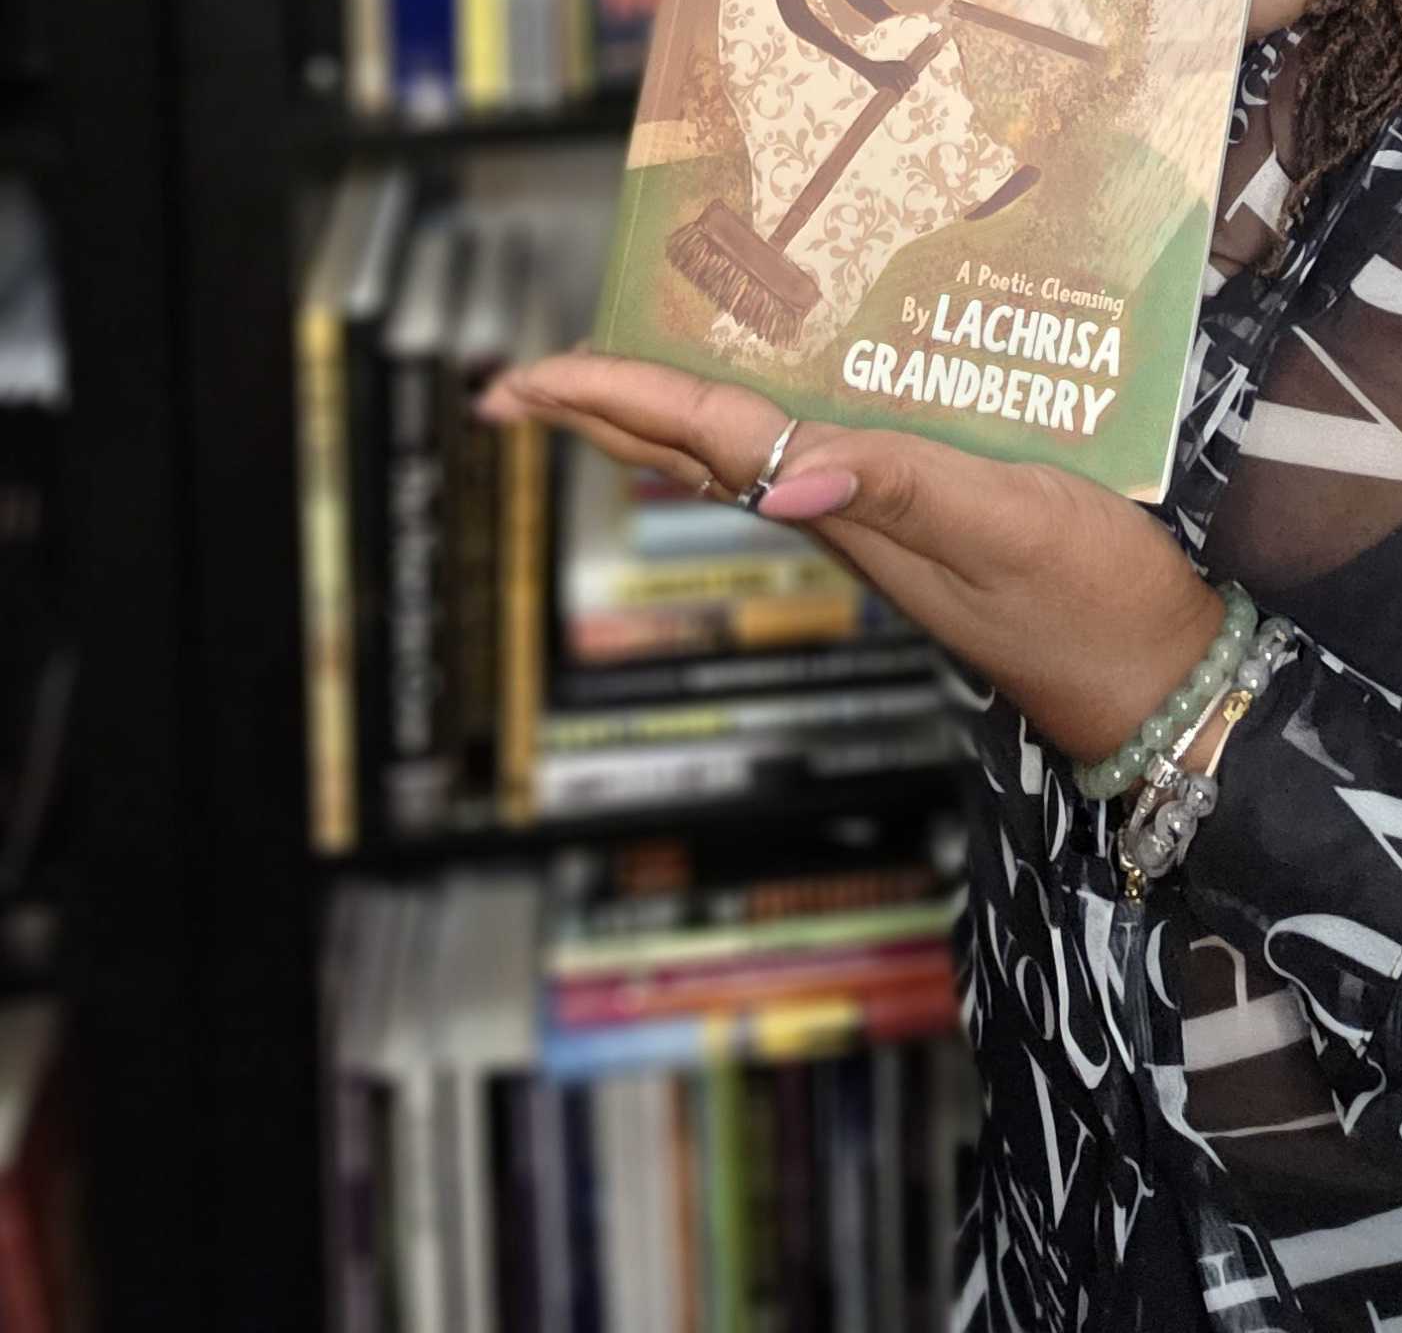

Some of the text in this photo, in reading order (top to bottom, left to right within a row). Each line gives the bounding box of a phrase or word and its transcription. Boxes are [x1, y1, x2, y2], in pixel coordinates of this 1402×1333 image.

[956, 260, 1125, 321] A Poetic Cleansing
[901, 293, 1122, 377] By LACHRISA
[842, 339, 1117, 436] GRANDBERRY
